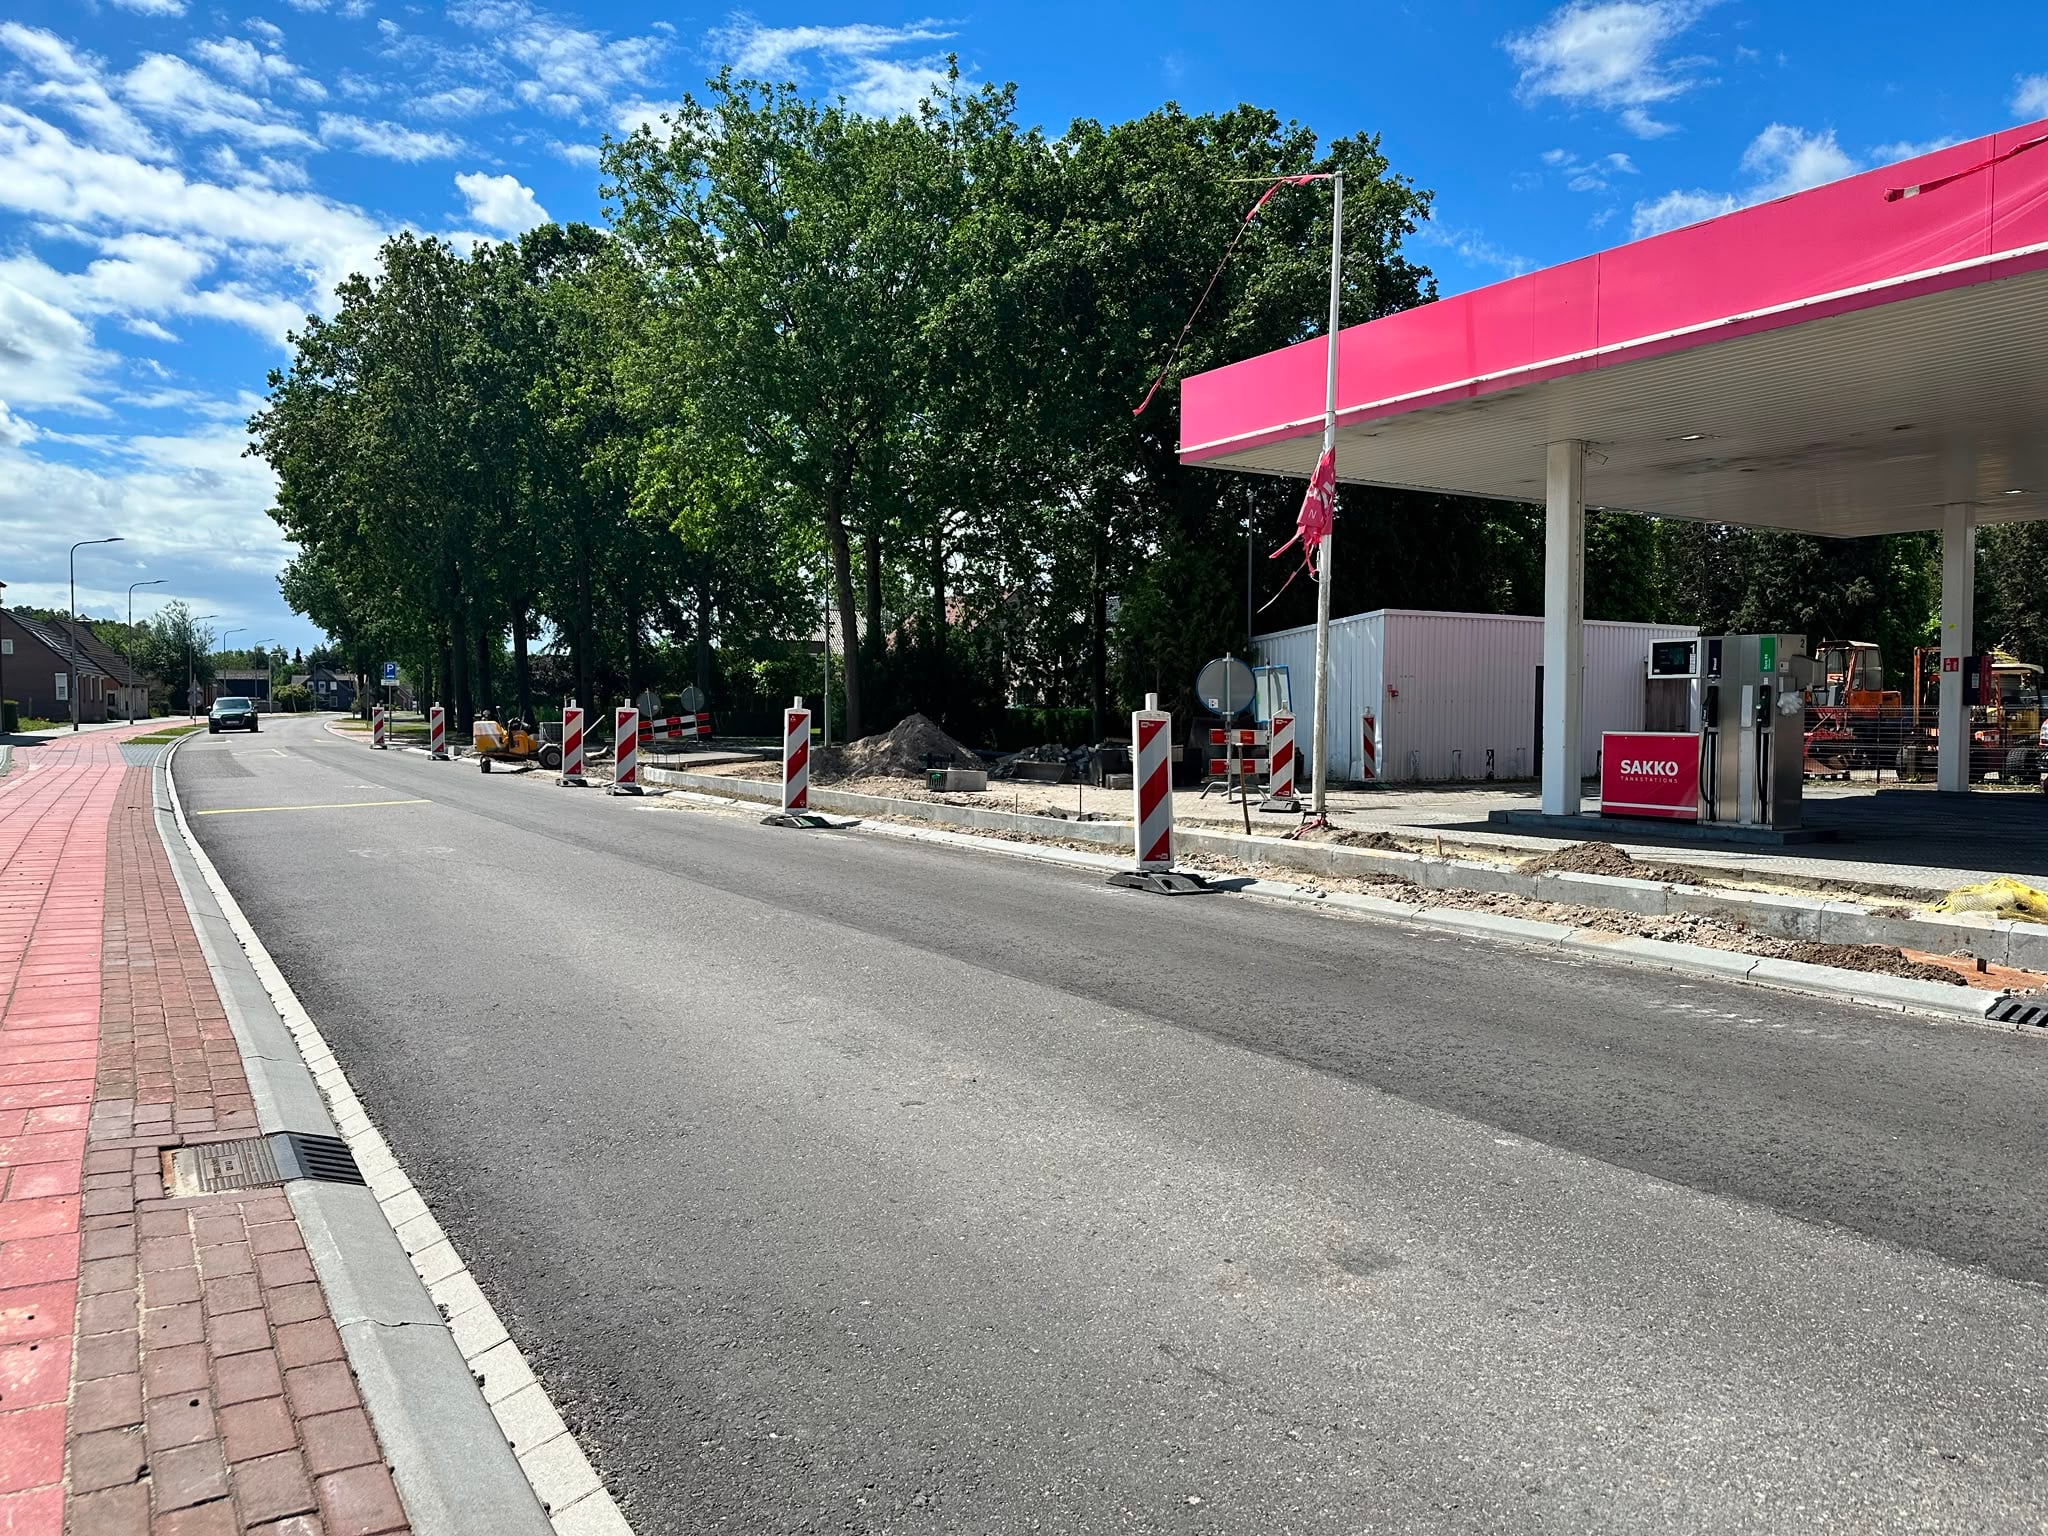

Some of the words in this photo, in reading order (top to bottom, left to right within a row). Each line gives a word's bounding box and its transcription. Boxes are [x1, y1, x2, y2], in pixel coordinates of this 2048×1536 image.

[1800, 639, 1804, 648] 2
[387, 664, 394, 672] P
[1620, 760, 1678, 776] SAKKO
